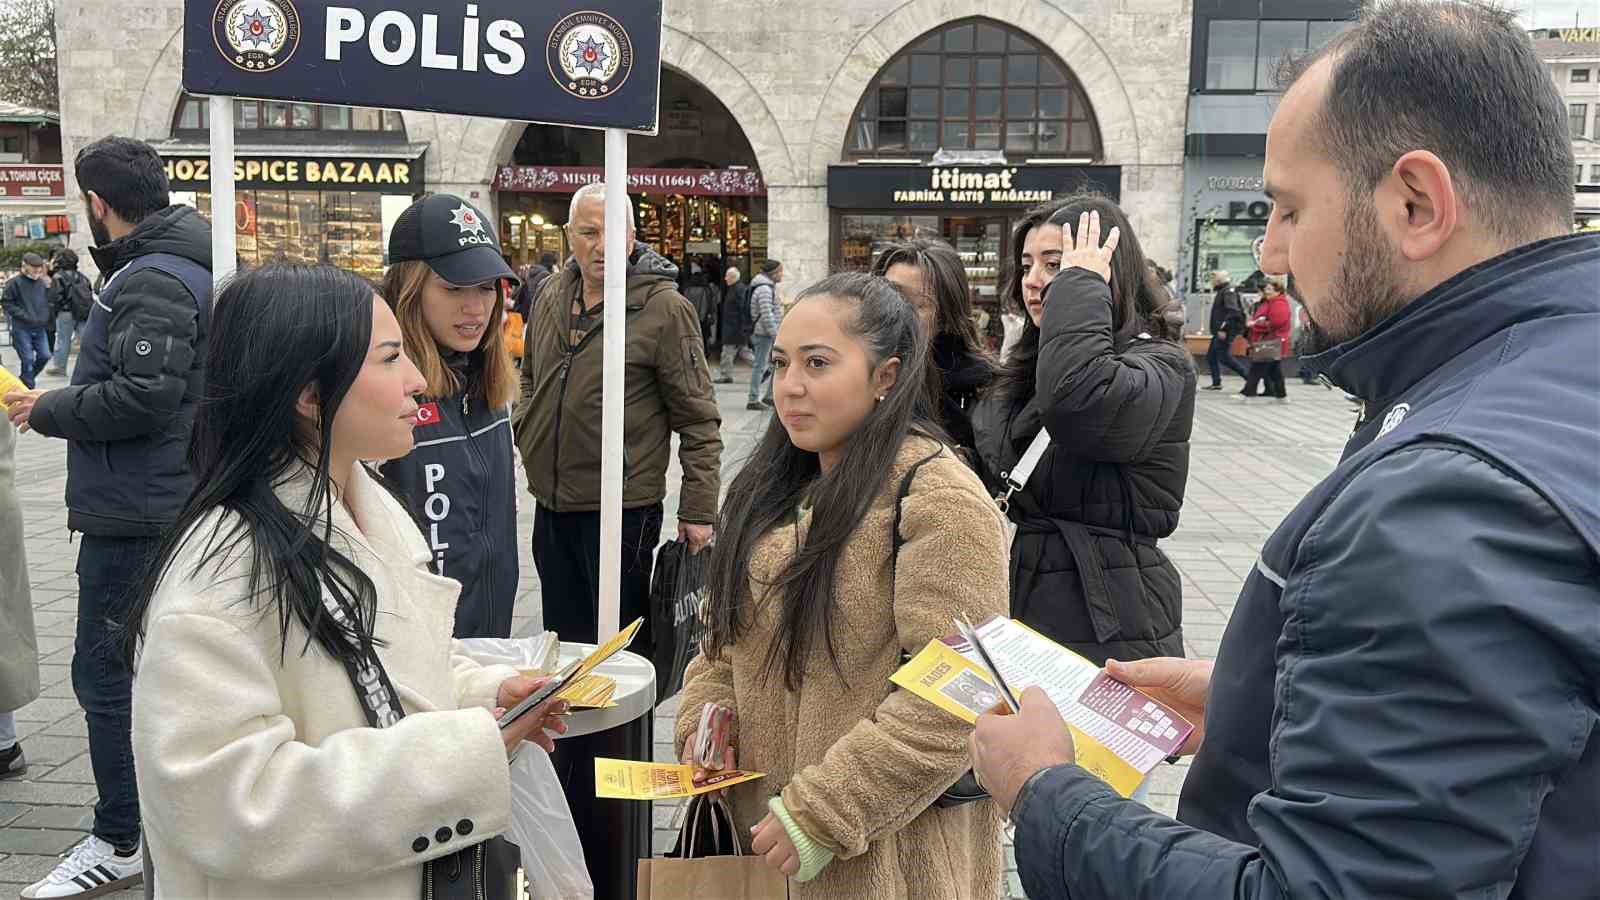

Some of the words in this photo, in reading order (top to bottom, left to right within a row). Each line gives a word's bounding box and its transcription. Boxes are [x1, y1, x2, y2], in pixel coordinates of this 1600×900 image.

[325, 4, 526, 76] POLİS
[234, 160, 298, 182] SPICE
[305, 161, 410, 184] BAZAAR
[659, 174, 697, 189] (1664)
[931, 167, 1013, 189] itimat
[893, 189, 945, 202] FABRİKA
[950, 190, 985, 203] SATIŞ
[991, 188, 1053, 202] MAĞAZASI
